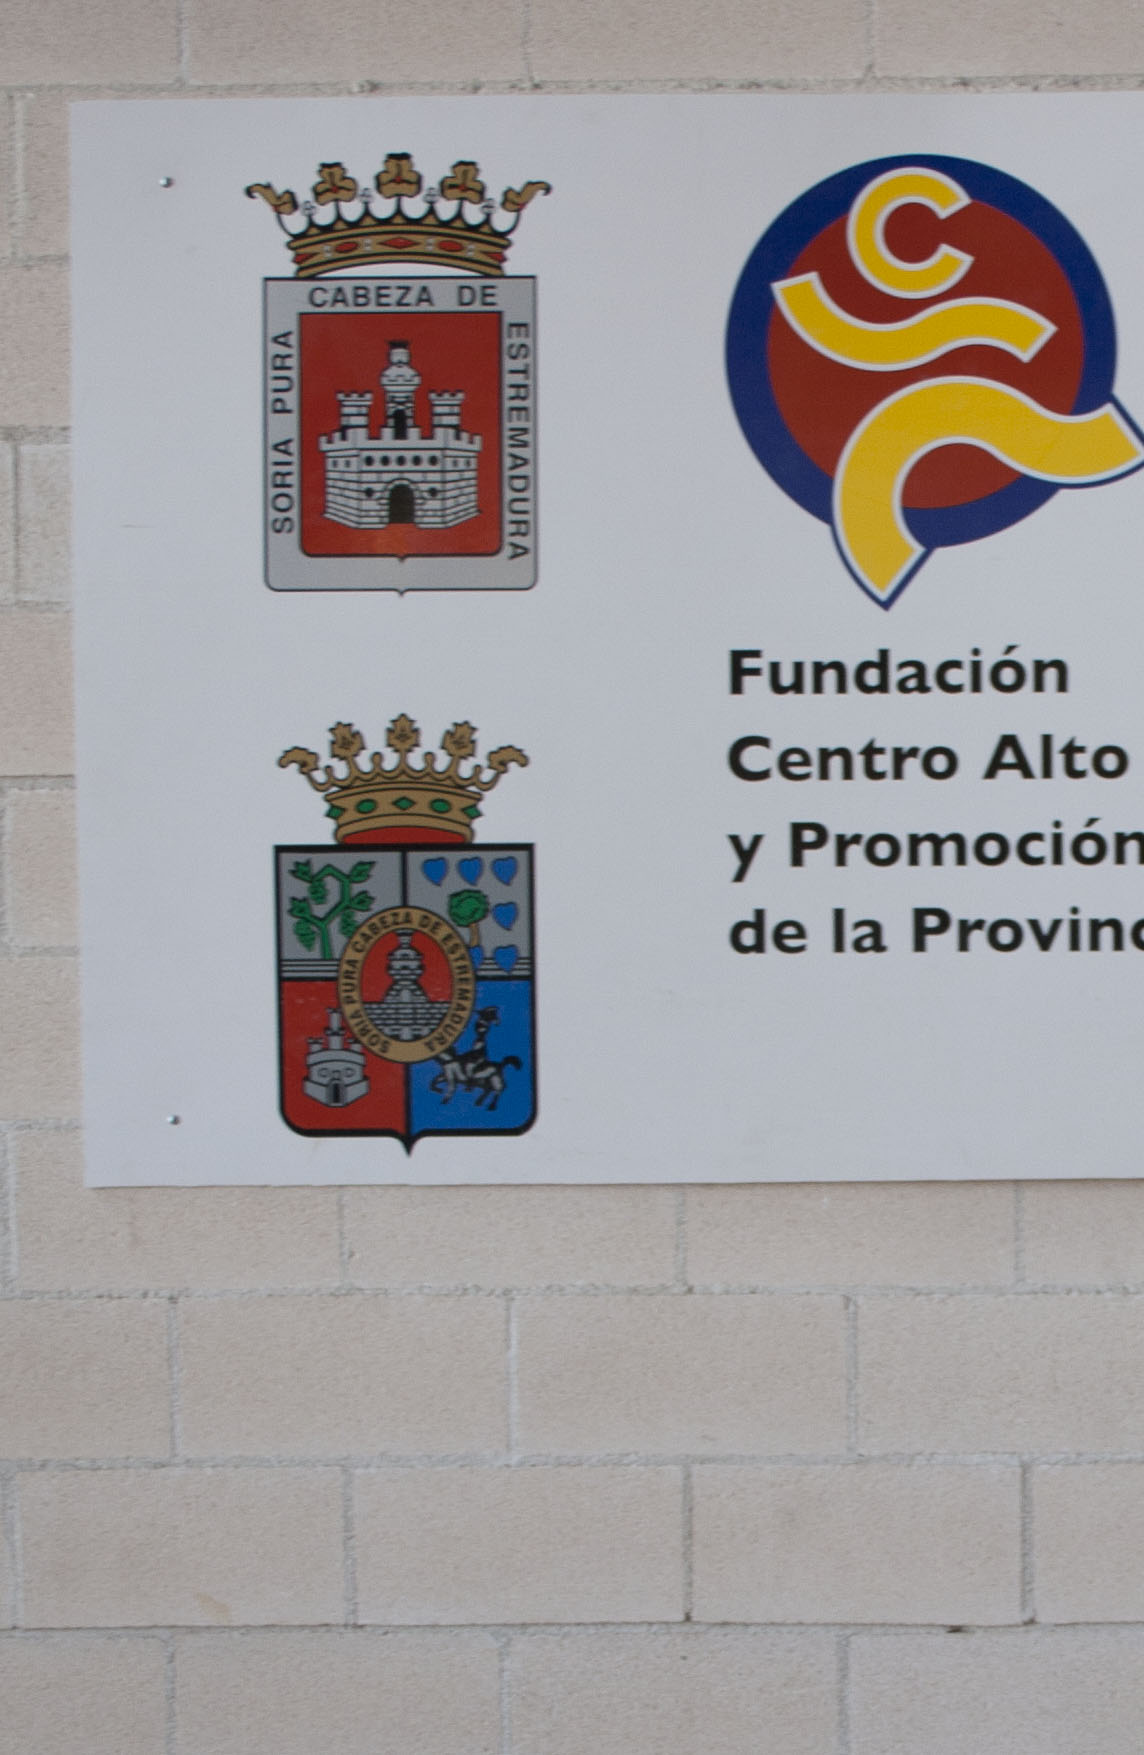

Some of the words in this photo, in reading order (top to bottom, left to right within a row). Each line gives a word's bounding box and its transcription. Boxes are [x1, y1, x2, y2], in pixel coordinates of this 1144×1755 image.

[309, 285, 435, 308] CABEZA
[457, 284, 497, 307] DE
[271, 330, 294, 415] PURA
[506, 322, 530, 560] ESTREMADURA
[271, 437, 294, 534] SORIA
[728, 644, 1069, 696] Fundación
[727, 735, 959, 782] Centro
[983, 733, 1130, 780] Alto
[727, 834, 764, 883] y
[352, 910, 412, 953] CABEZA
[417, 913, 443, 935] DE
[728, 908, 808, 955] de
[832, 907, 888, 954] la
[423, 932, 472, 1052] ESTREMADURA
[350, 1008, 391, 1054] SORIA
